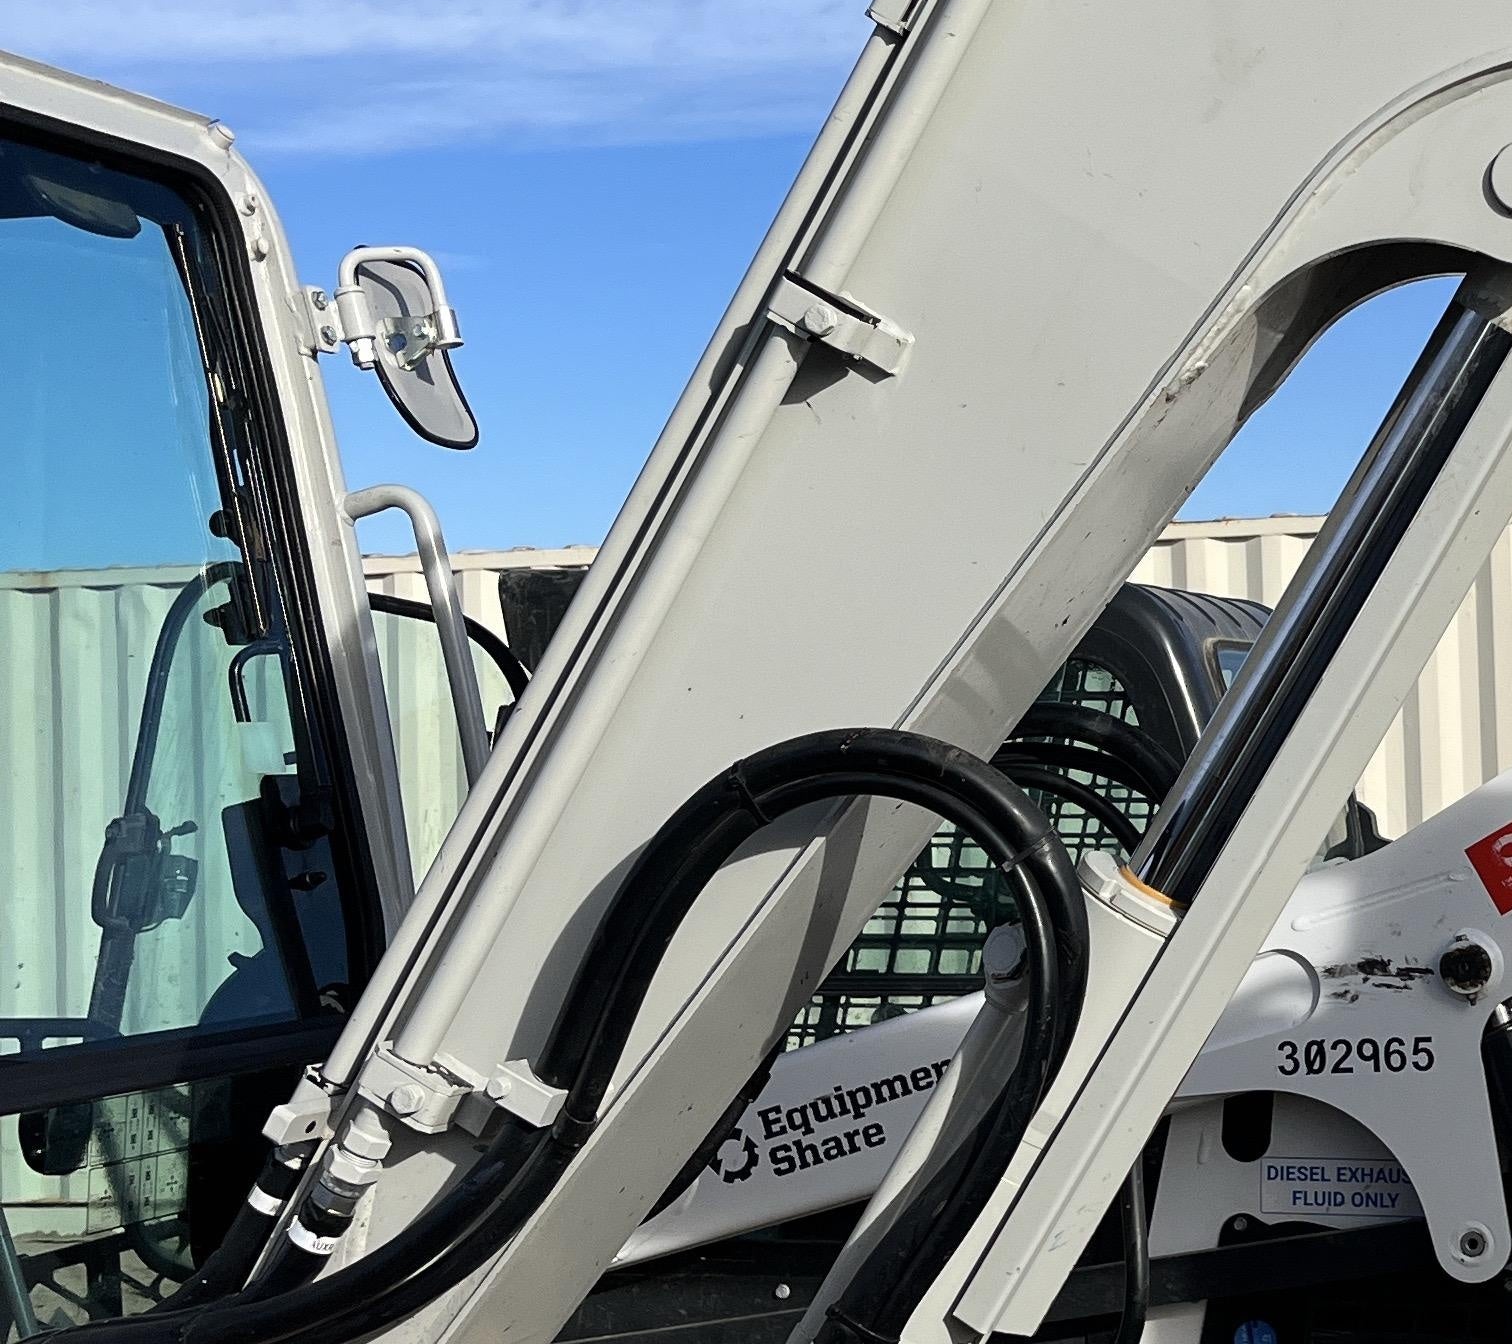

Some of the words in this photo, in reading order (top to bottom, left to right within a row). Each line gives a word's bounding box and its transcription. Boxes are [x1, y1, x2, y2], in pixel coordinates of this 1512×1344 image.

[1277, 1035, 1435, 1076] 302965
[768, 1122, 886, 1177] Share
[1266, 1165, 1331, 1183] DIESEL
[1336, 1166, 1411, 1184] EXHAUS
[1291, 1190, 1345, 1207] FLUID
[1351, 1191, 1399, 1209] ONLY
